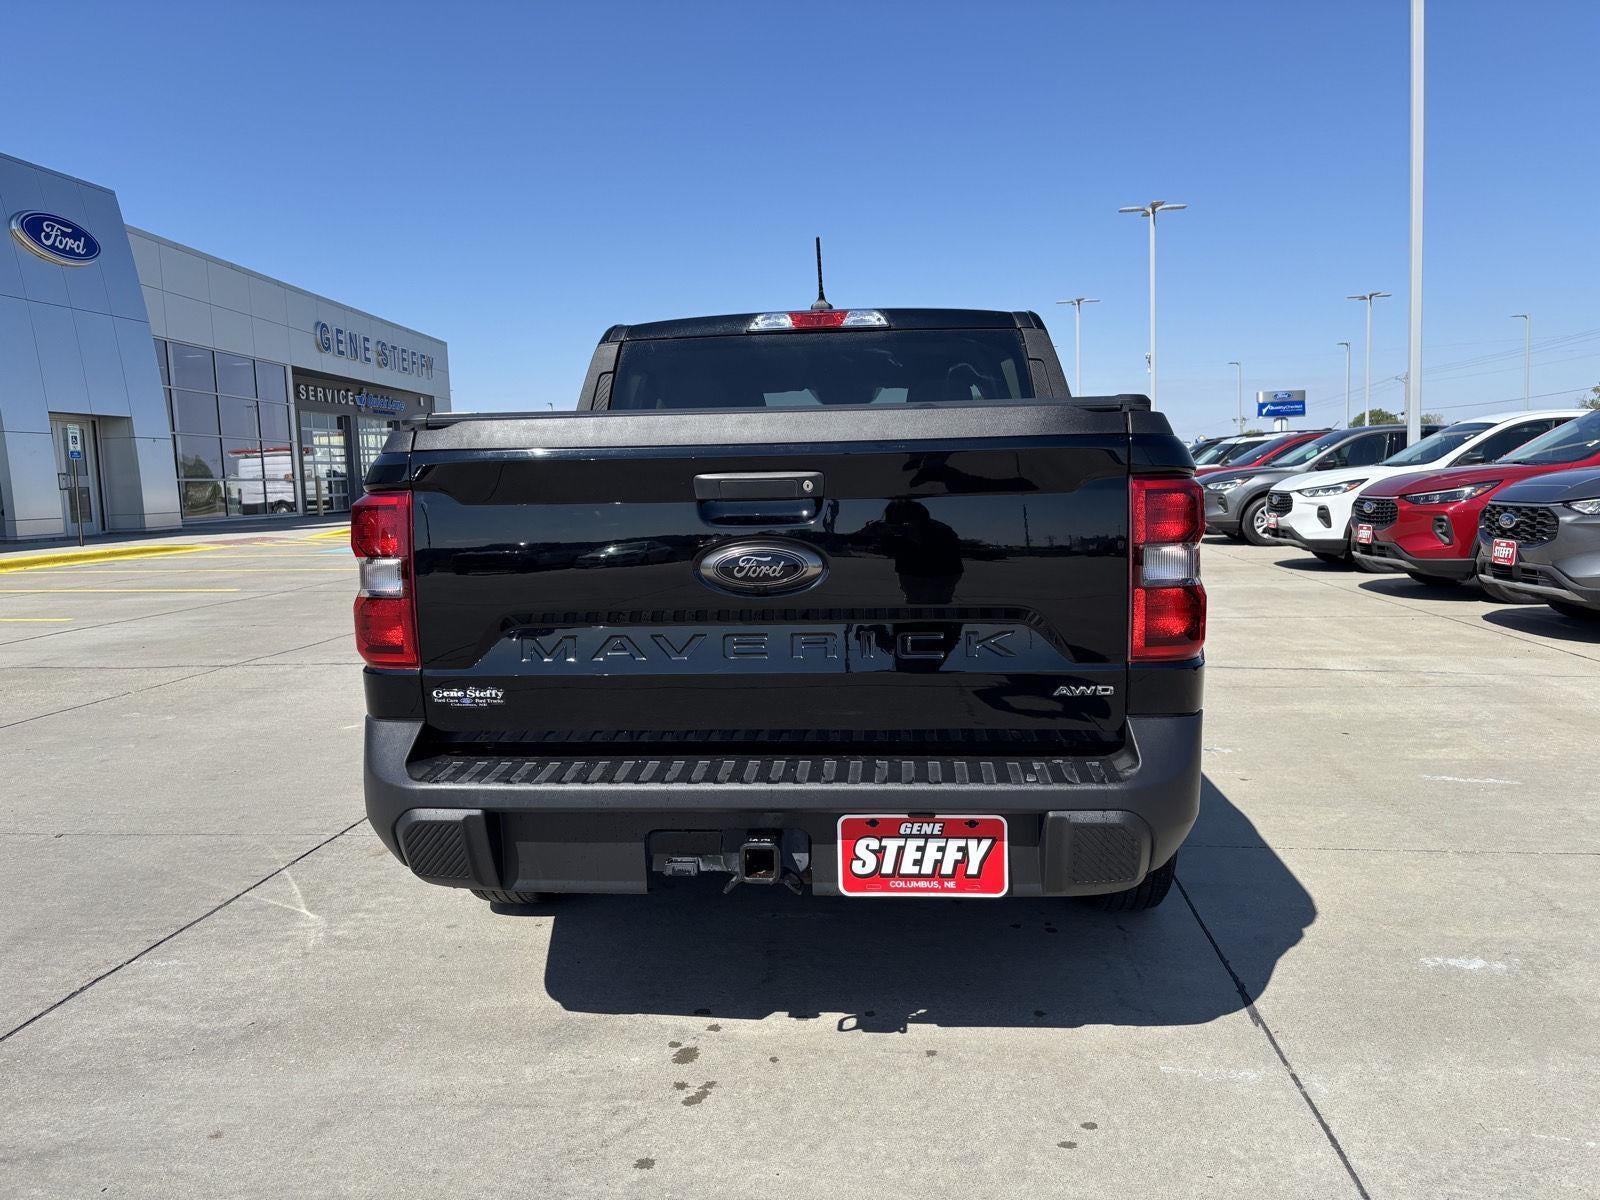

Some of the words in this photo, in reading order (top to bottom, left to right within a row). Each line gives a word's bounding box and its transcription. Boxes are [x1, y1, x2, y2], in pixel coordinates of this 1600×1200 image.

[41, 221, 86, 255] Ford
[316, 321, 372, 364] GENE
[377, 341, 434, 379] STEFFY
[299, 384, 354, 405] SERVICE
[1494, 546, 1513, 558] STEFFY
[733, 556, 785, 578] Ford
[519, 632, 1017, 662] MAVERICK
[432, 690, 465, 698] Gene
[466, 689, 504, 699] Steffy
[1053, 685, 1114, 696] AWD
[899, 822, 944, 835] GENE
[851, 837, 994, 876] STEFFY
[889, 880, 942, 890] COLUMBUS,
[943, 881, 957, 889] NE
